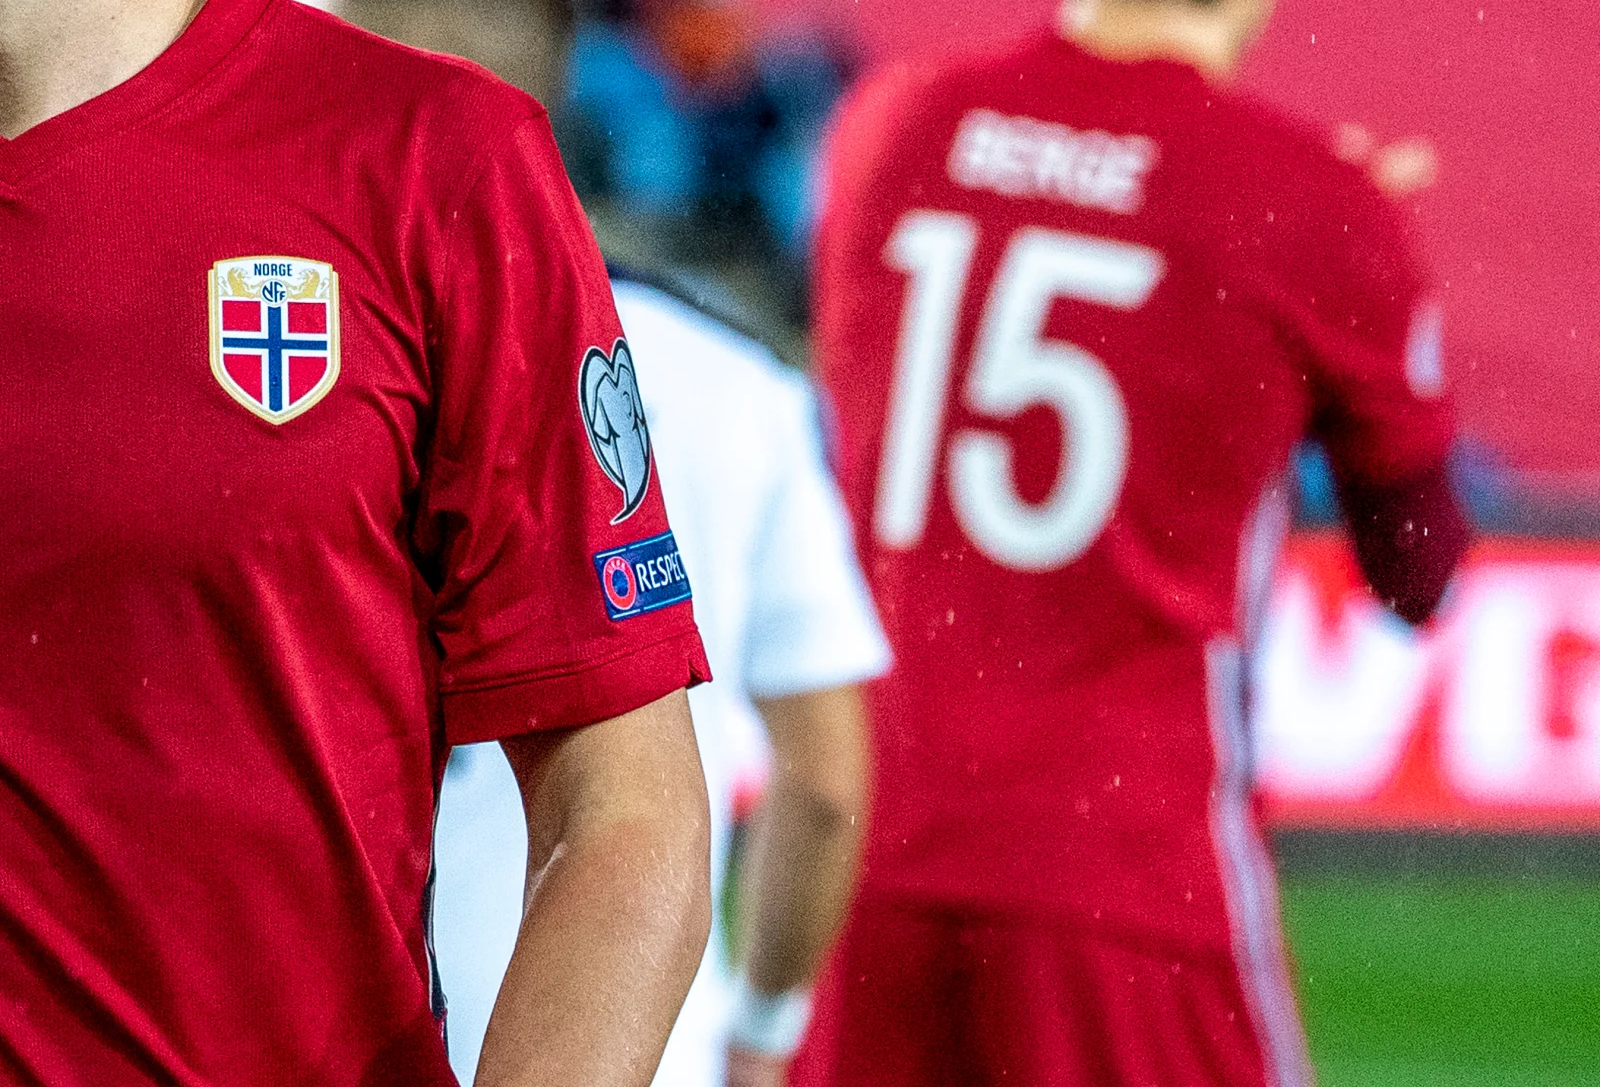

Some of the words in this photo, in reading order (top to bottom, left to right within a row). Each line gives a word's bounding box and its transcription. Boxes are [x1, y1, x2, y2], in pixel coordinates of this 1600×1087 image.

[254, 263, 292, 276] NORGE
[875, 210, 1162, 570] 15
[636, 551, 685, 592] RESPEC
